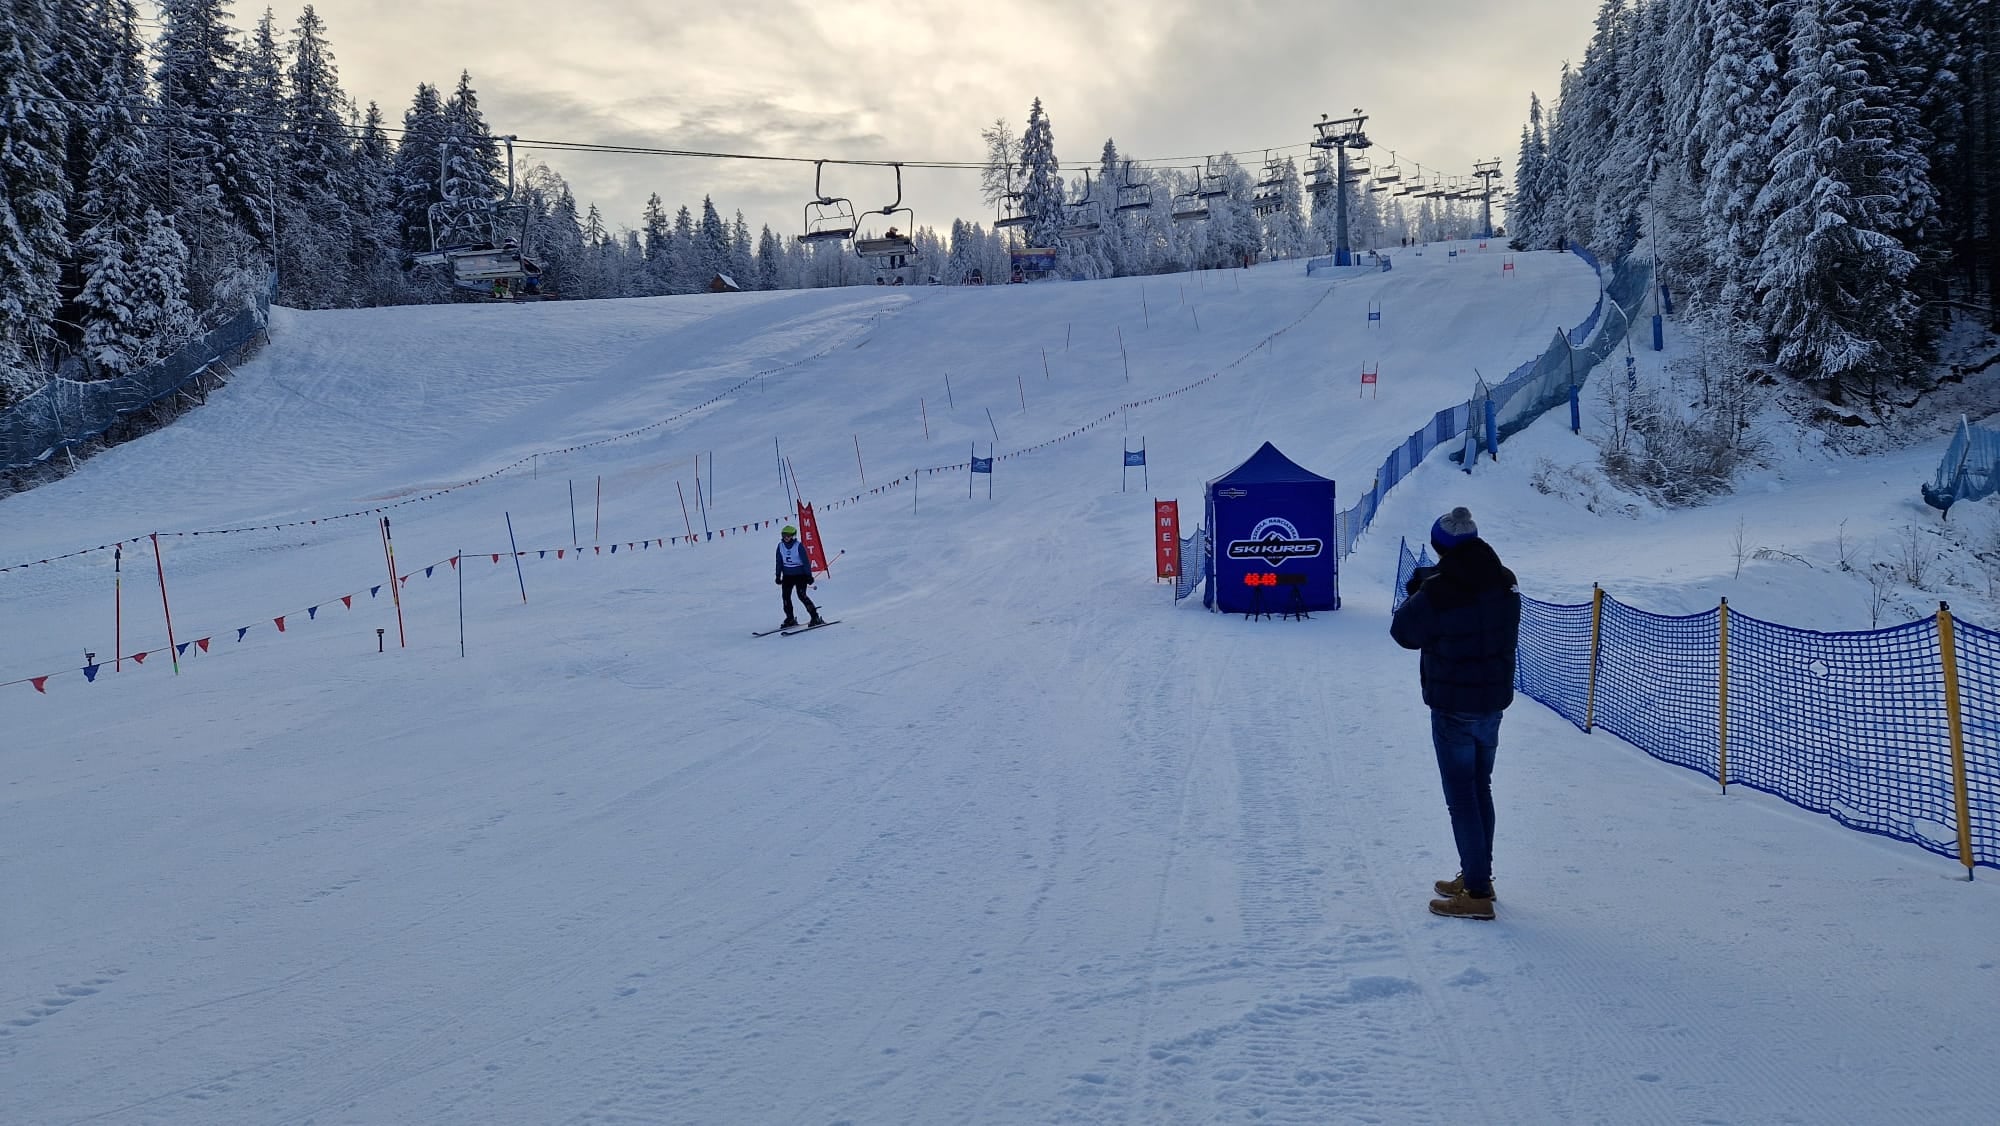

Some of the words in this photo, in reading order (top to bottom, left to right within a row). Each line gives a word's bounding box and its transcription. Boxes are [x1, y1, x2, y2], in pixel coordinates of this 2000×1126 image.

[804, 518, 818, 568] META
[1161, 517, 1174, 571] META
[1231, 545, 1260, 554] SKI
[1261, 544, 1317, 554] KUROS
